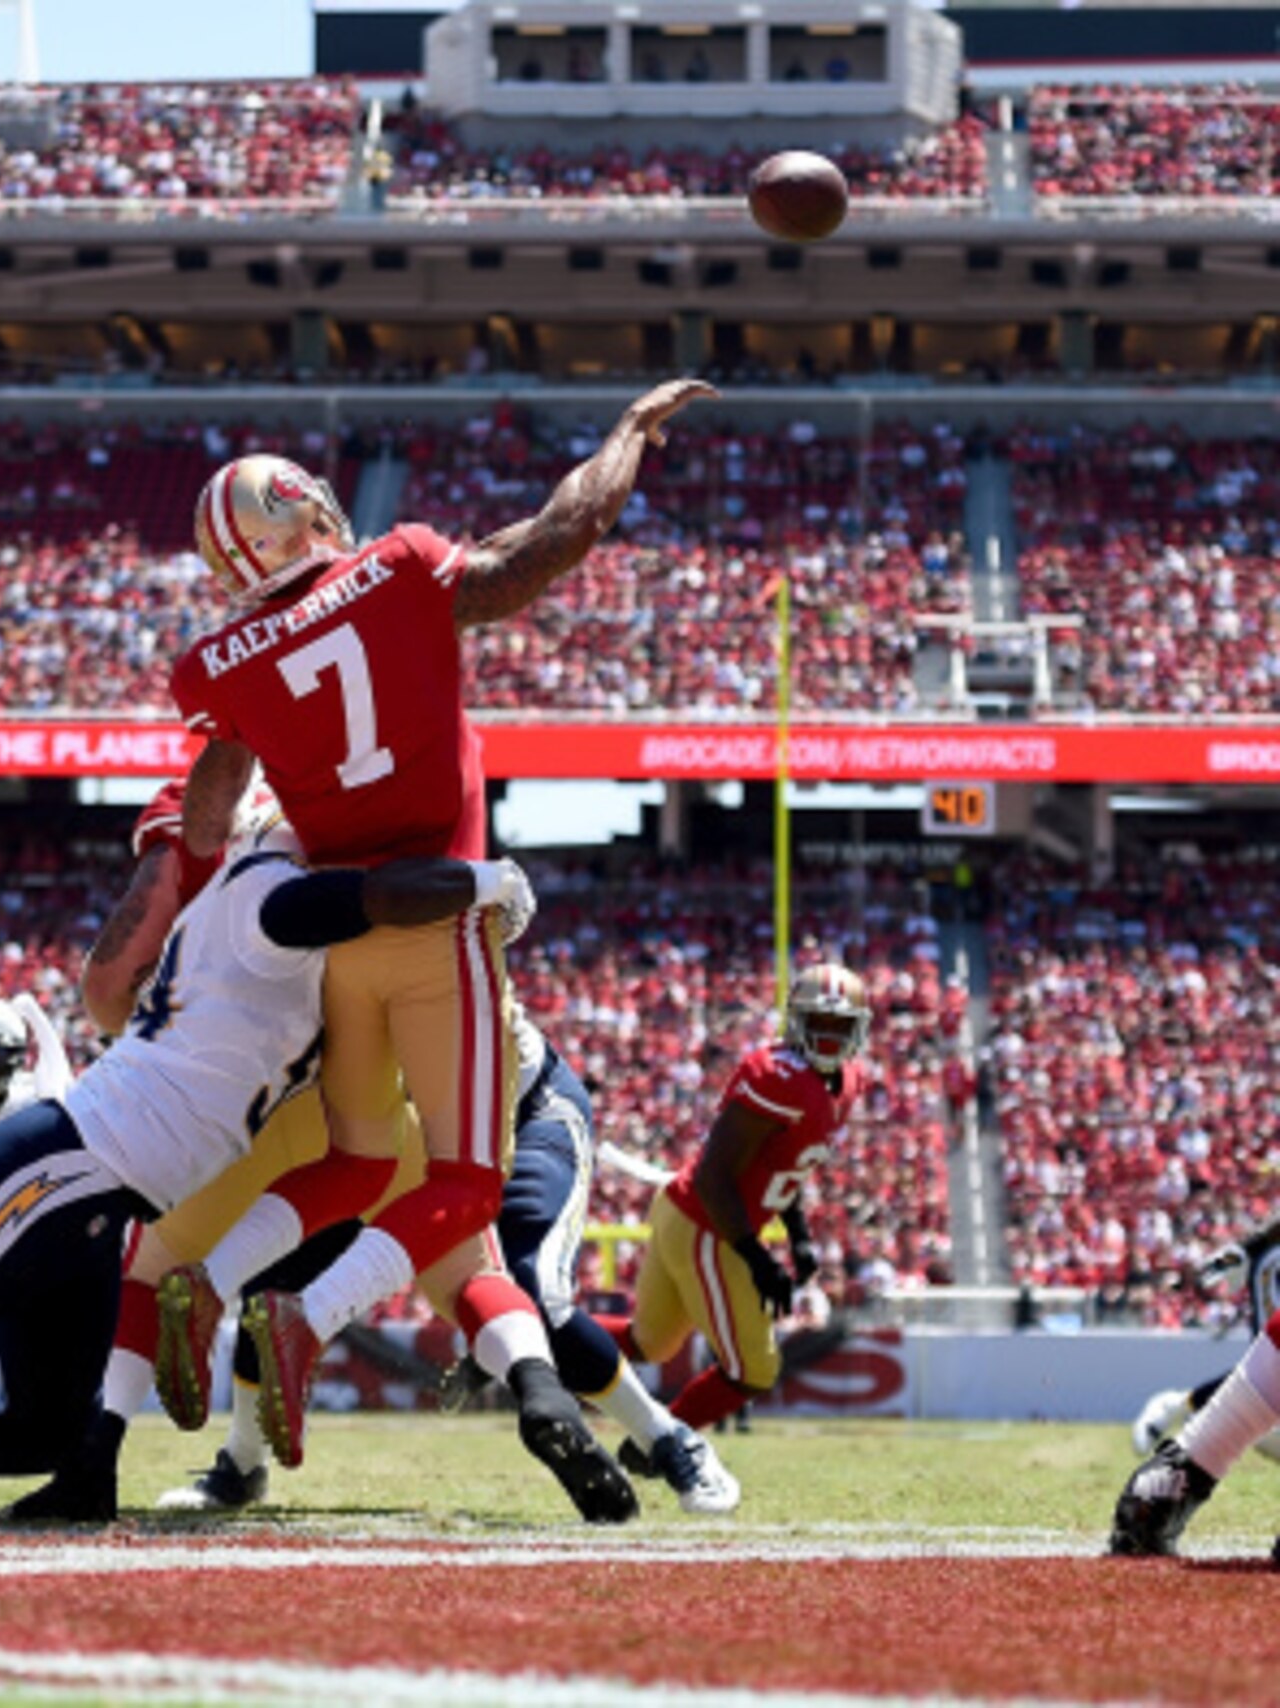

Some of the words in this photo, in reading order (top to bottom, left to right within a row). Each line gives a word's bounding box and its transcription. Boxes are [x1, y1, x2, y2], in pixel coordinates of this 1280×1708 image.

[200, 553, 394, 680] KAEPERNICK
[275, 622, 395, 789] 7
[932, 788, 987, 826] 40
